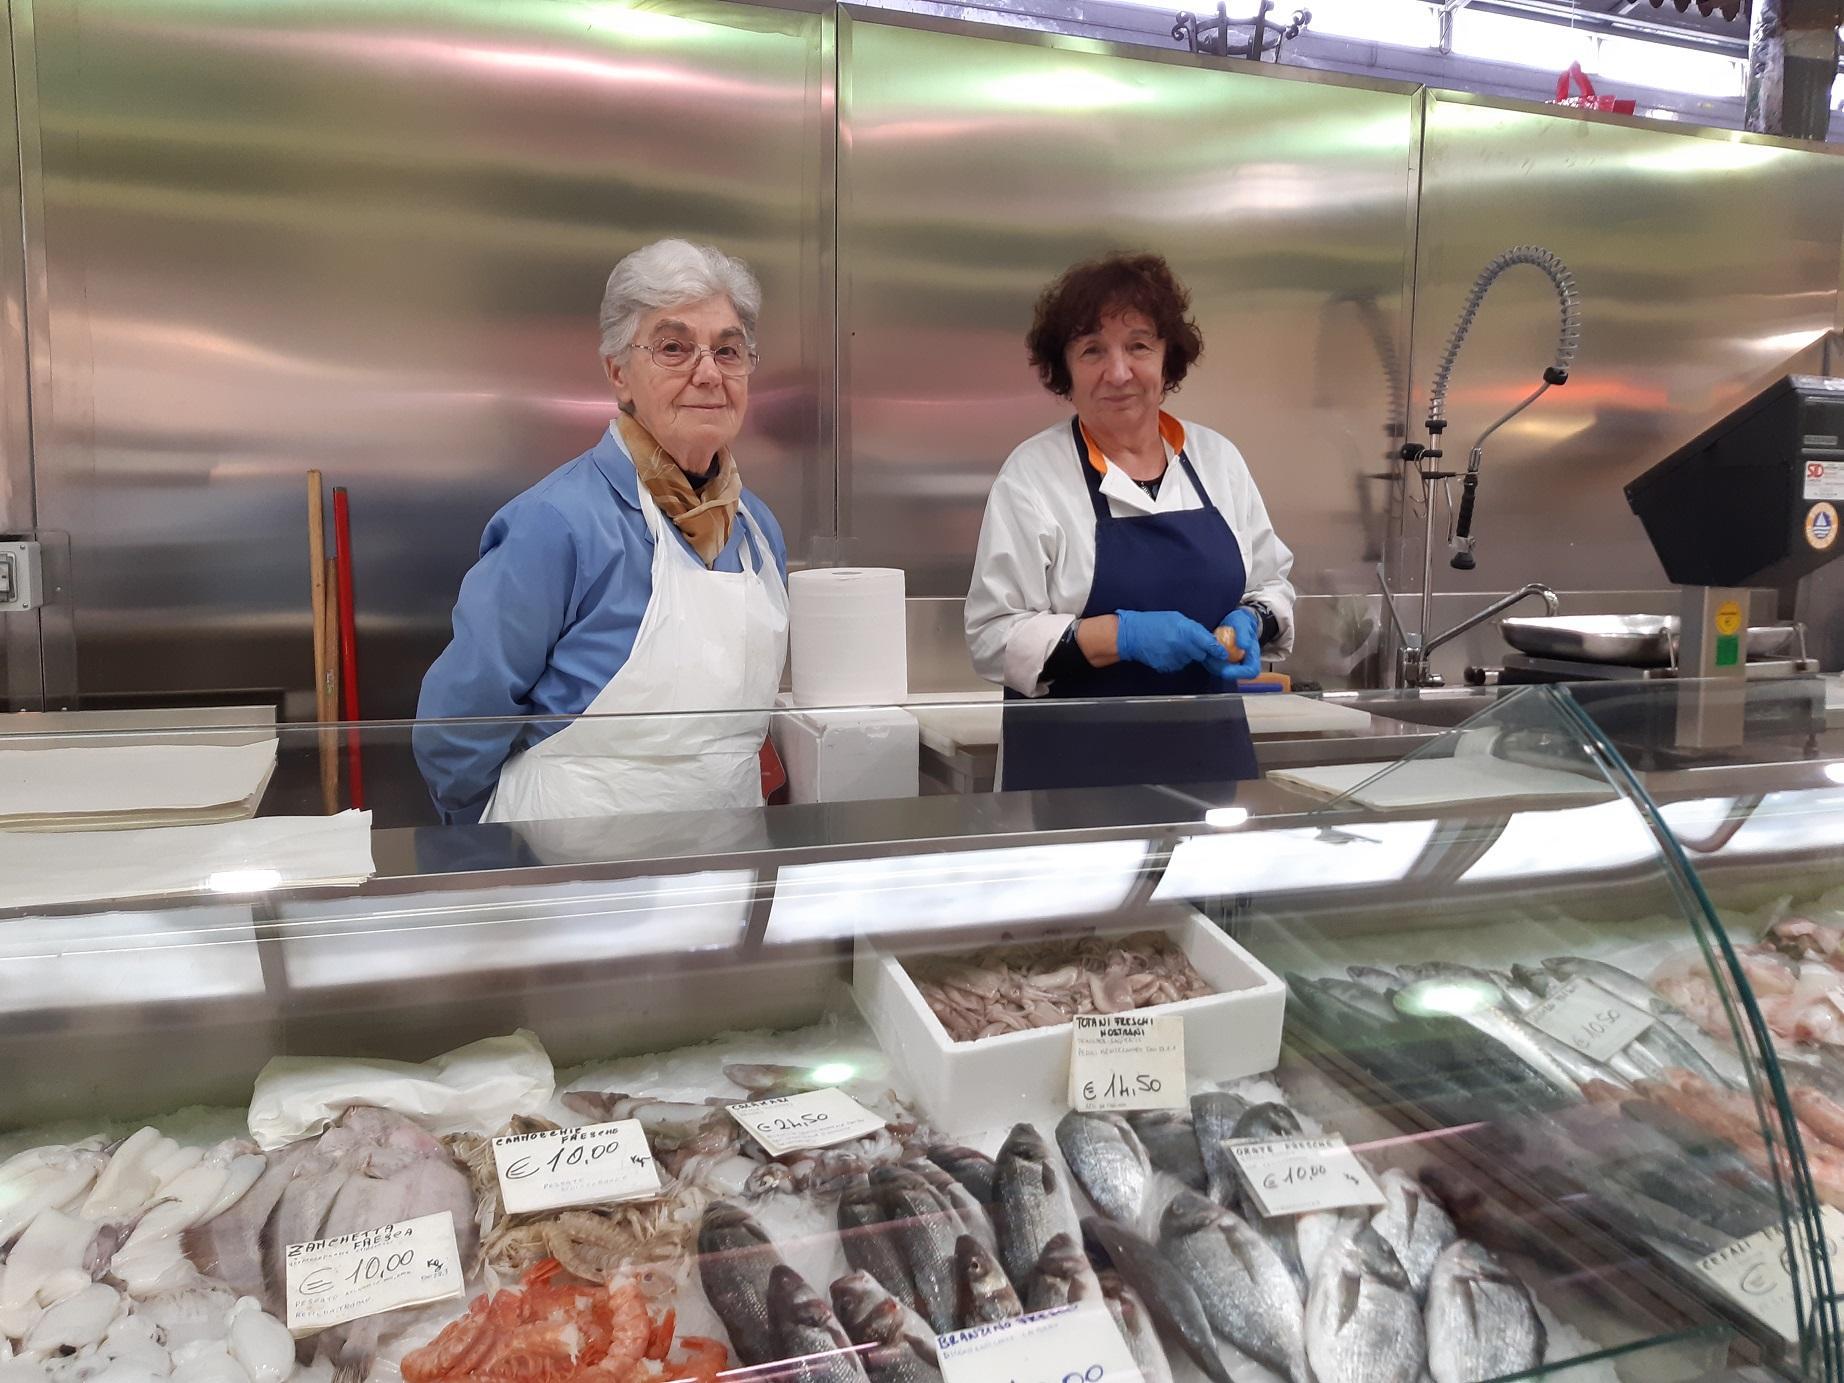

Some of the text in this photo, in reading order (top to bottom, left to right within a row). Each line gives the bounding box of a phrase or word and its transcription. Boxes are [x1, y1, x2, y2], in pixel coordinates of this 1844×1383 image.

[1076, 1016, 1154, 1029] TOTANI FRESCHI
[1100, 1028, 1145, 1037] NOSTRANI
[1104, 1073, 1161, 1098] 14,50
[547, 1141, 619, 1173] 10,00
[288, 1224, 394, 1258] ZANCHETTA
[353, 1228, 413, 1250] FRESCA
[344, 1249, 415, 1284] 10,00
